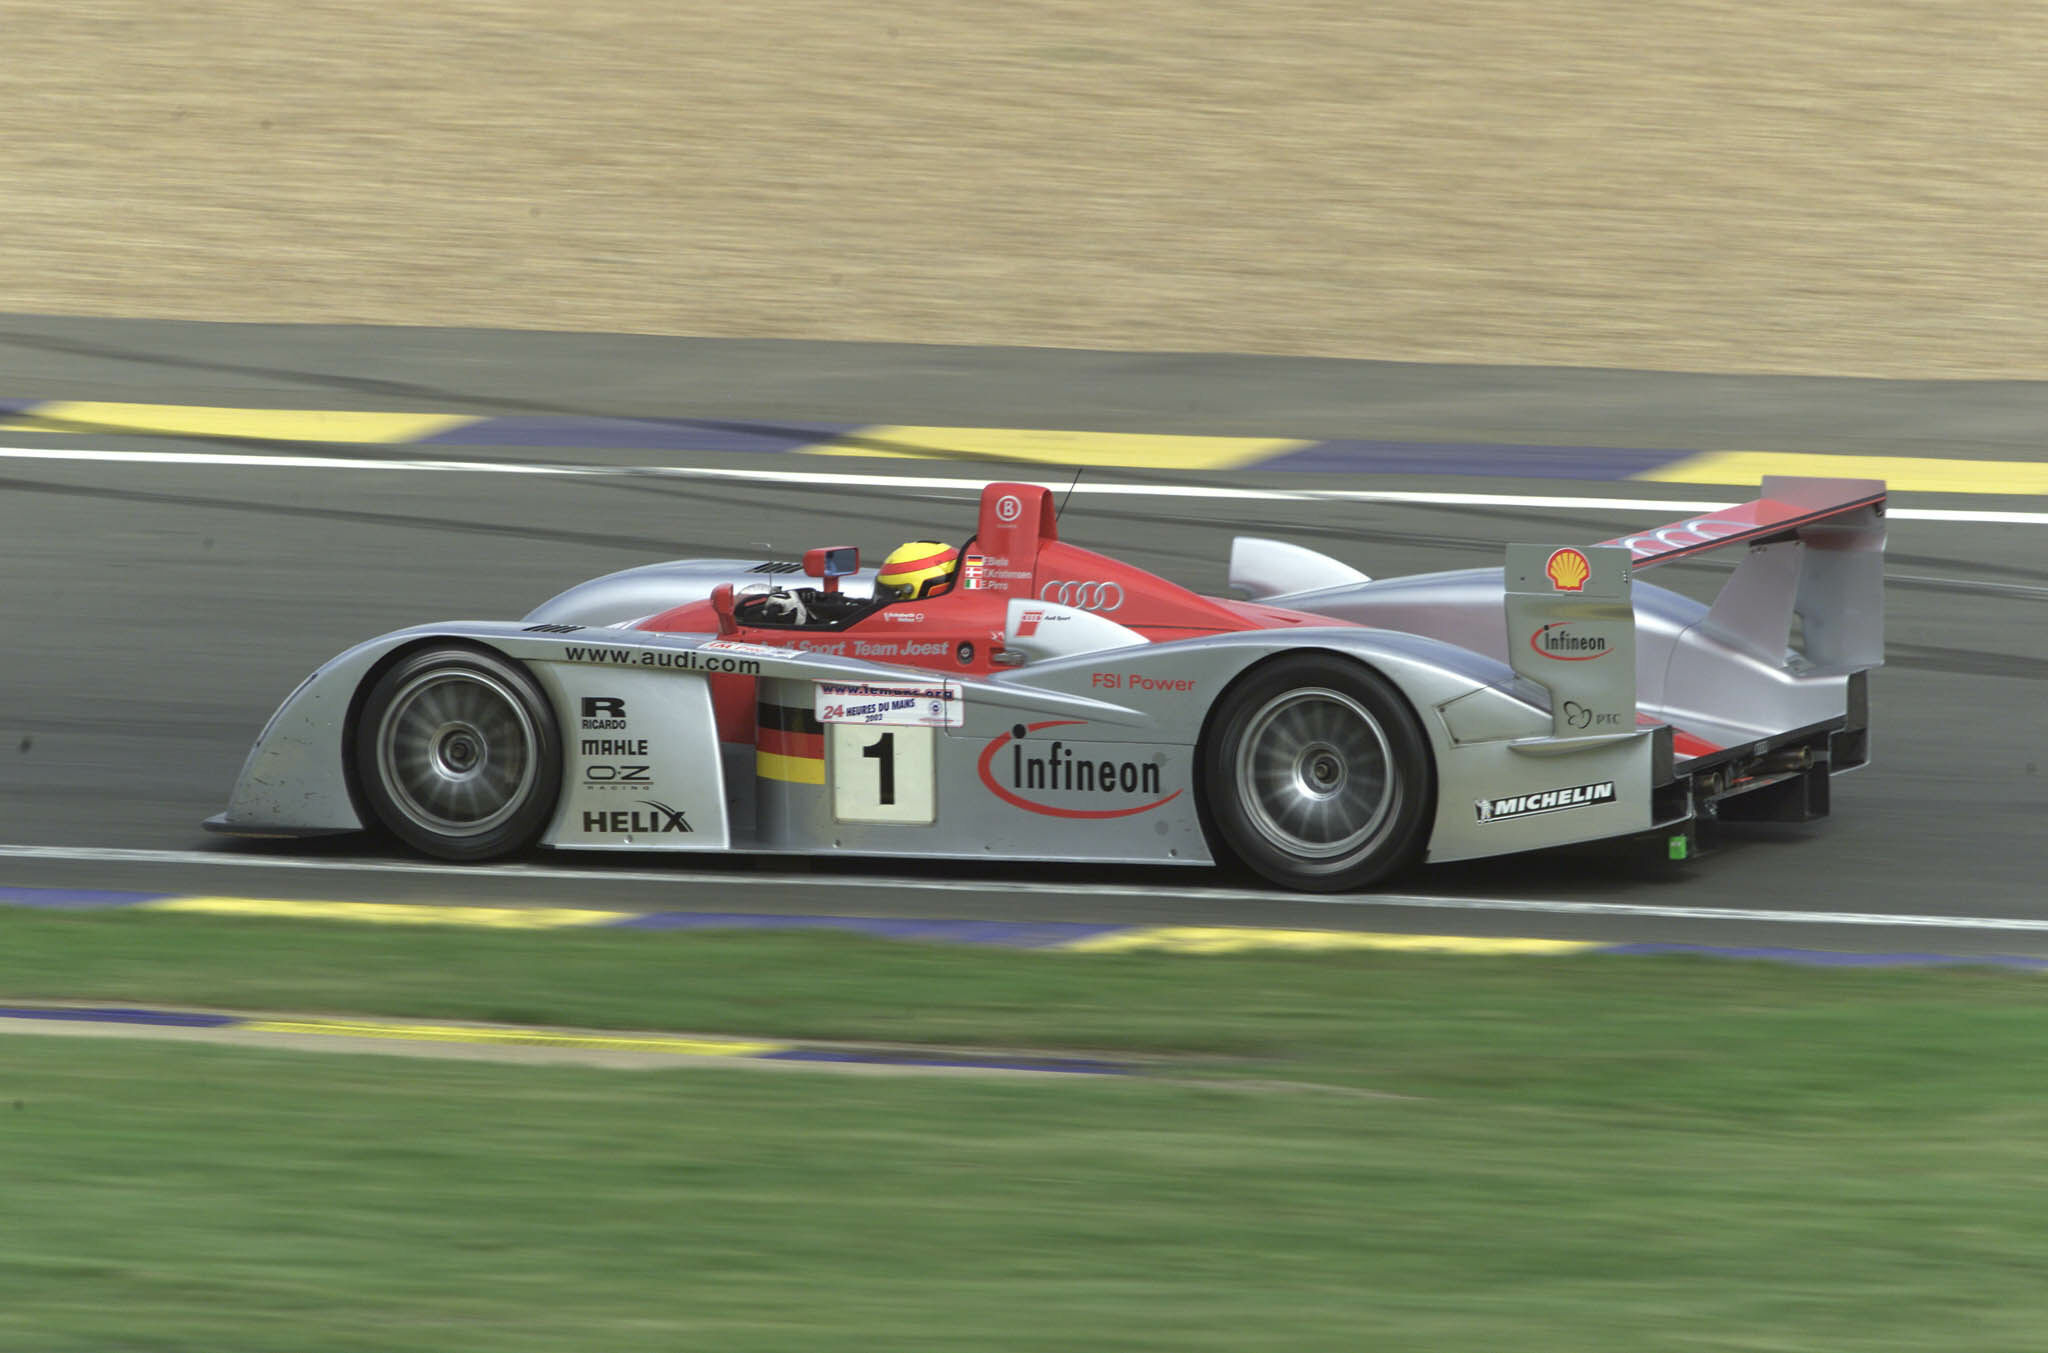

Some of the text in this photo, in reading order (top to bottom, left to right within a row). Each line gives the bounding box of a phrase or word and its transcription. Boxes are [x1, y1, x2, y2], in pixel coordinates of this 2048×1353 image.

[854, 640, 898, 656] Team
[900, 639, 949, 656] Joest
[565, 646, 761, 674] www.audi.com
[1092, 672, 1198, 691] FSI Power
[581, 697, 626, 718] R
[823, 698, 916, 719] 24 HEURES DU MANS
[582, 719, 626, 730] RICARDO
[1596, 713, 1622, 725] PTC
[581, 740, 648, 755] MAHLE
[863, 732, 895, 805] 1
[1494, 783, 1612, 815] MICHELIN
[583, 810, 694, 833] HELIX
